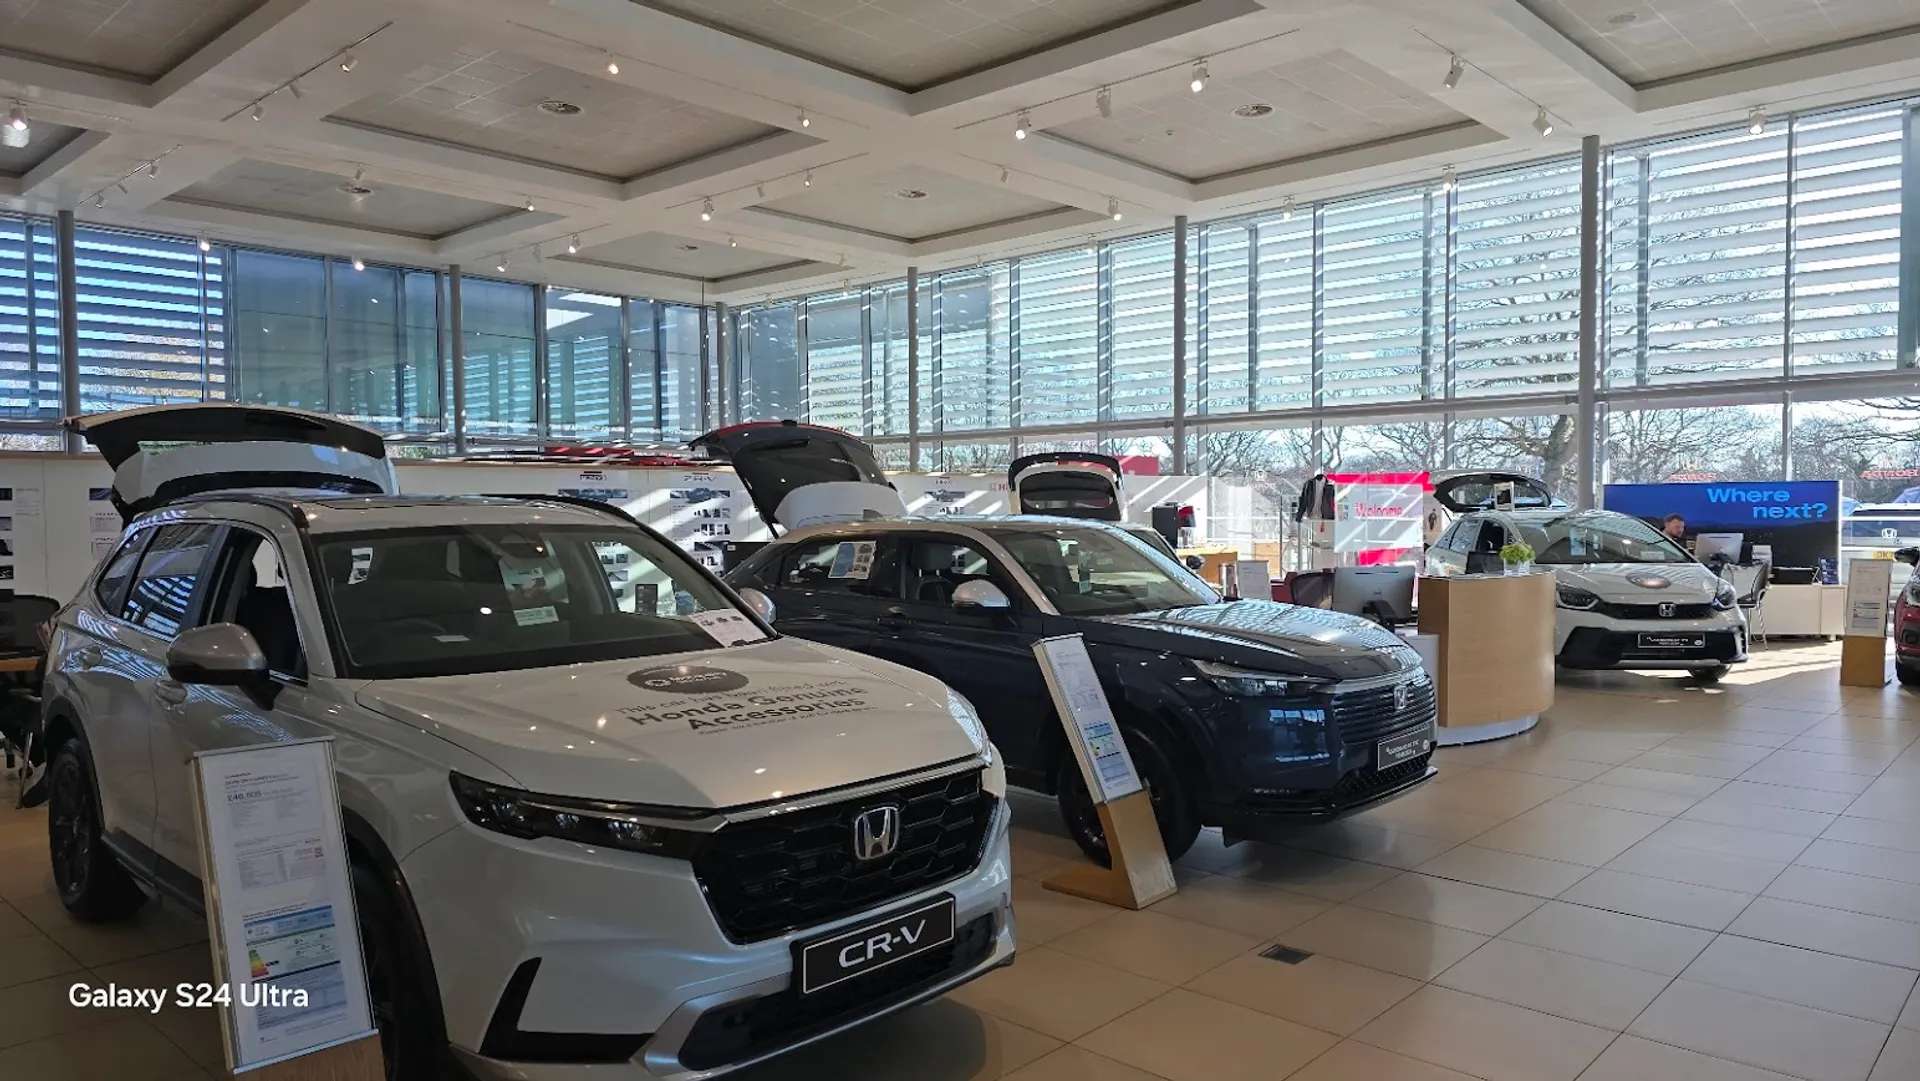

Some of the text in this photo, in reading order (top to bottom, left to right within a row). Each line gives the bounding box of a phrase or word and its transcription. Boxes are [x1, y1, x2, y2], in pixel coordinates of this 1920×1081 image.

[1706, 487, 1791, 503] Where
[1355, 501, 1403, 517] Welcome
[1752, 502, 1828, 519] next?
[627, 701, 745, 726] Honda
[747, 687, 868, 706] Genuine
[688, 697, 866, 731] Accessories
[838, 919, 927, 968] CR-V
